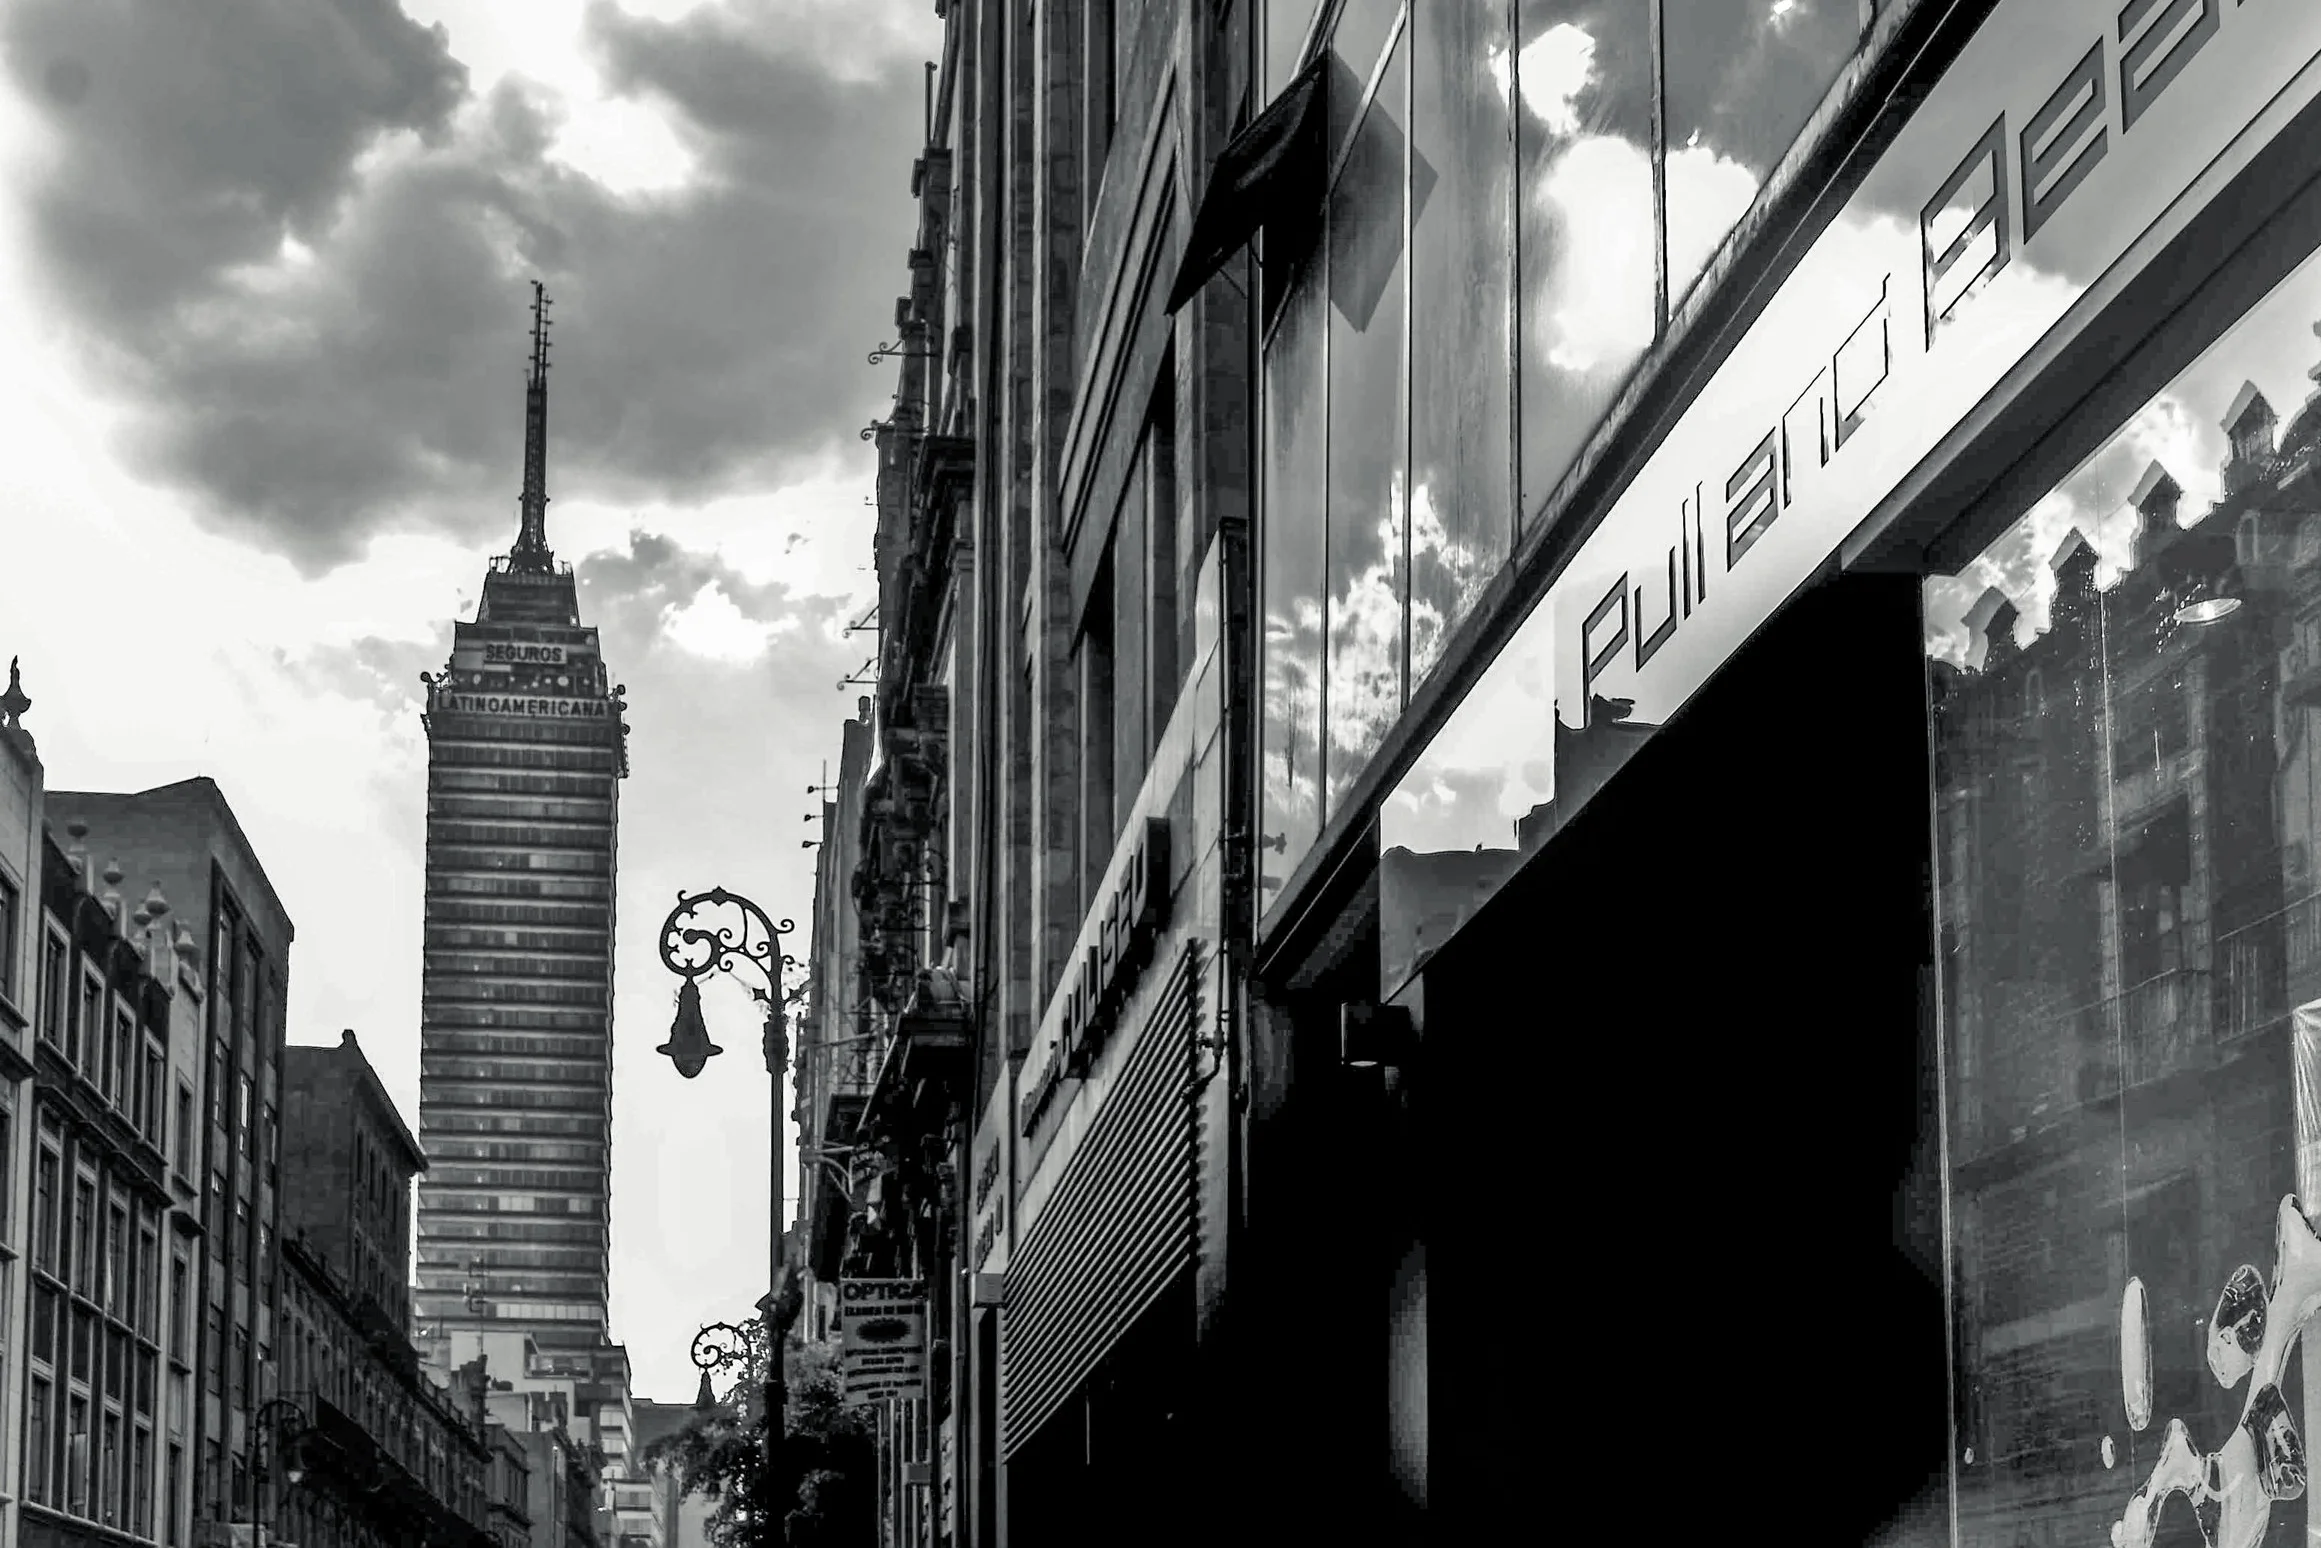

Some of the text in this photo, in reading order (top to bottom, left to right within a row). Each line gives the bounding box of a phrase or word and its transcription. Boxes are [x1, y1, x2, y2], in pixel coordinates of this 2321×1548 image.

[1582, 0, 2246, 728] Pull and Bea
[439, 693, 606, 716] LATINOAMERICANA
[486, 644, 563, 663] SEGUROS
[1060, 816, 1152, 1080] COLISEO
